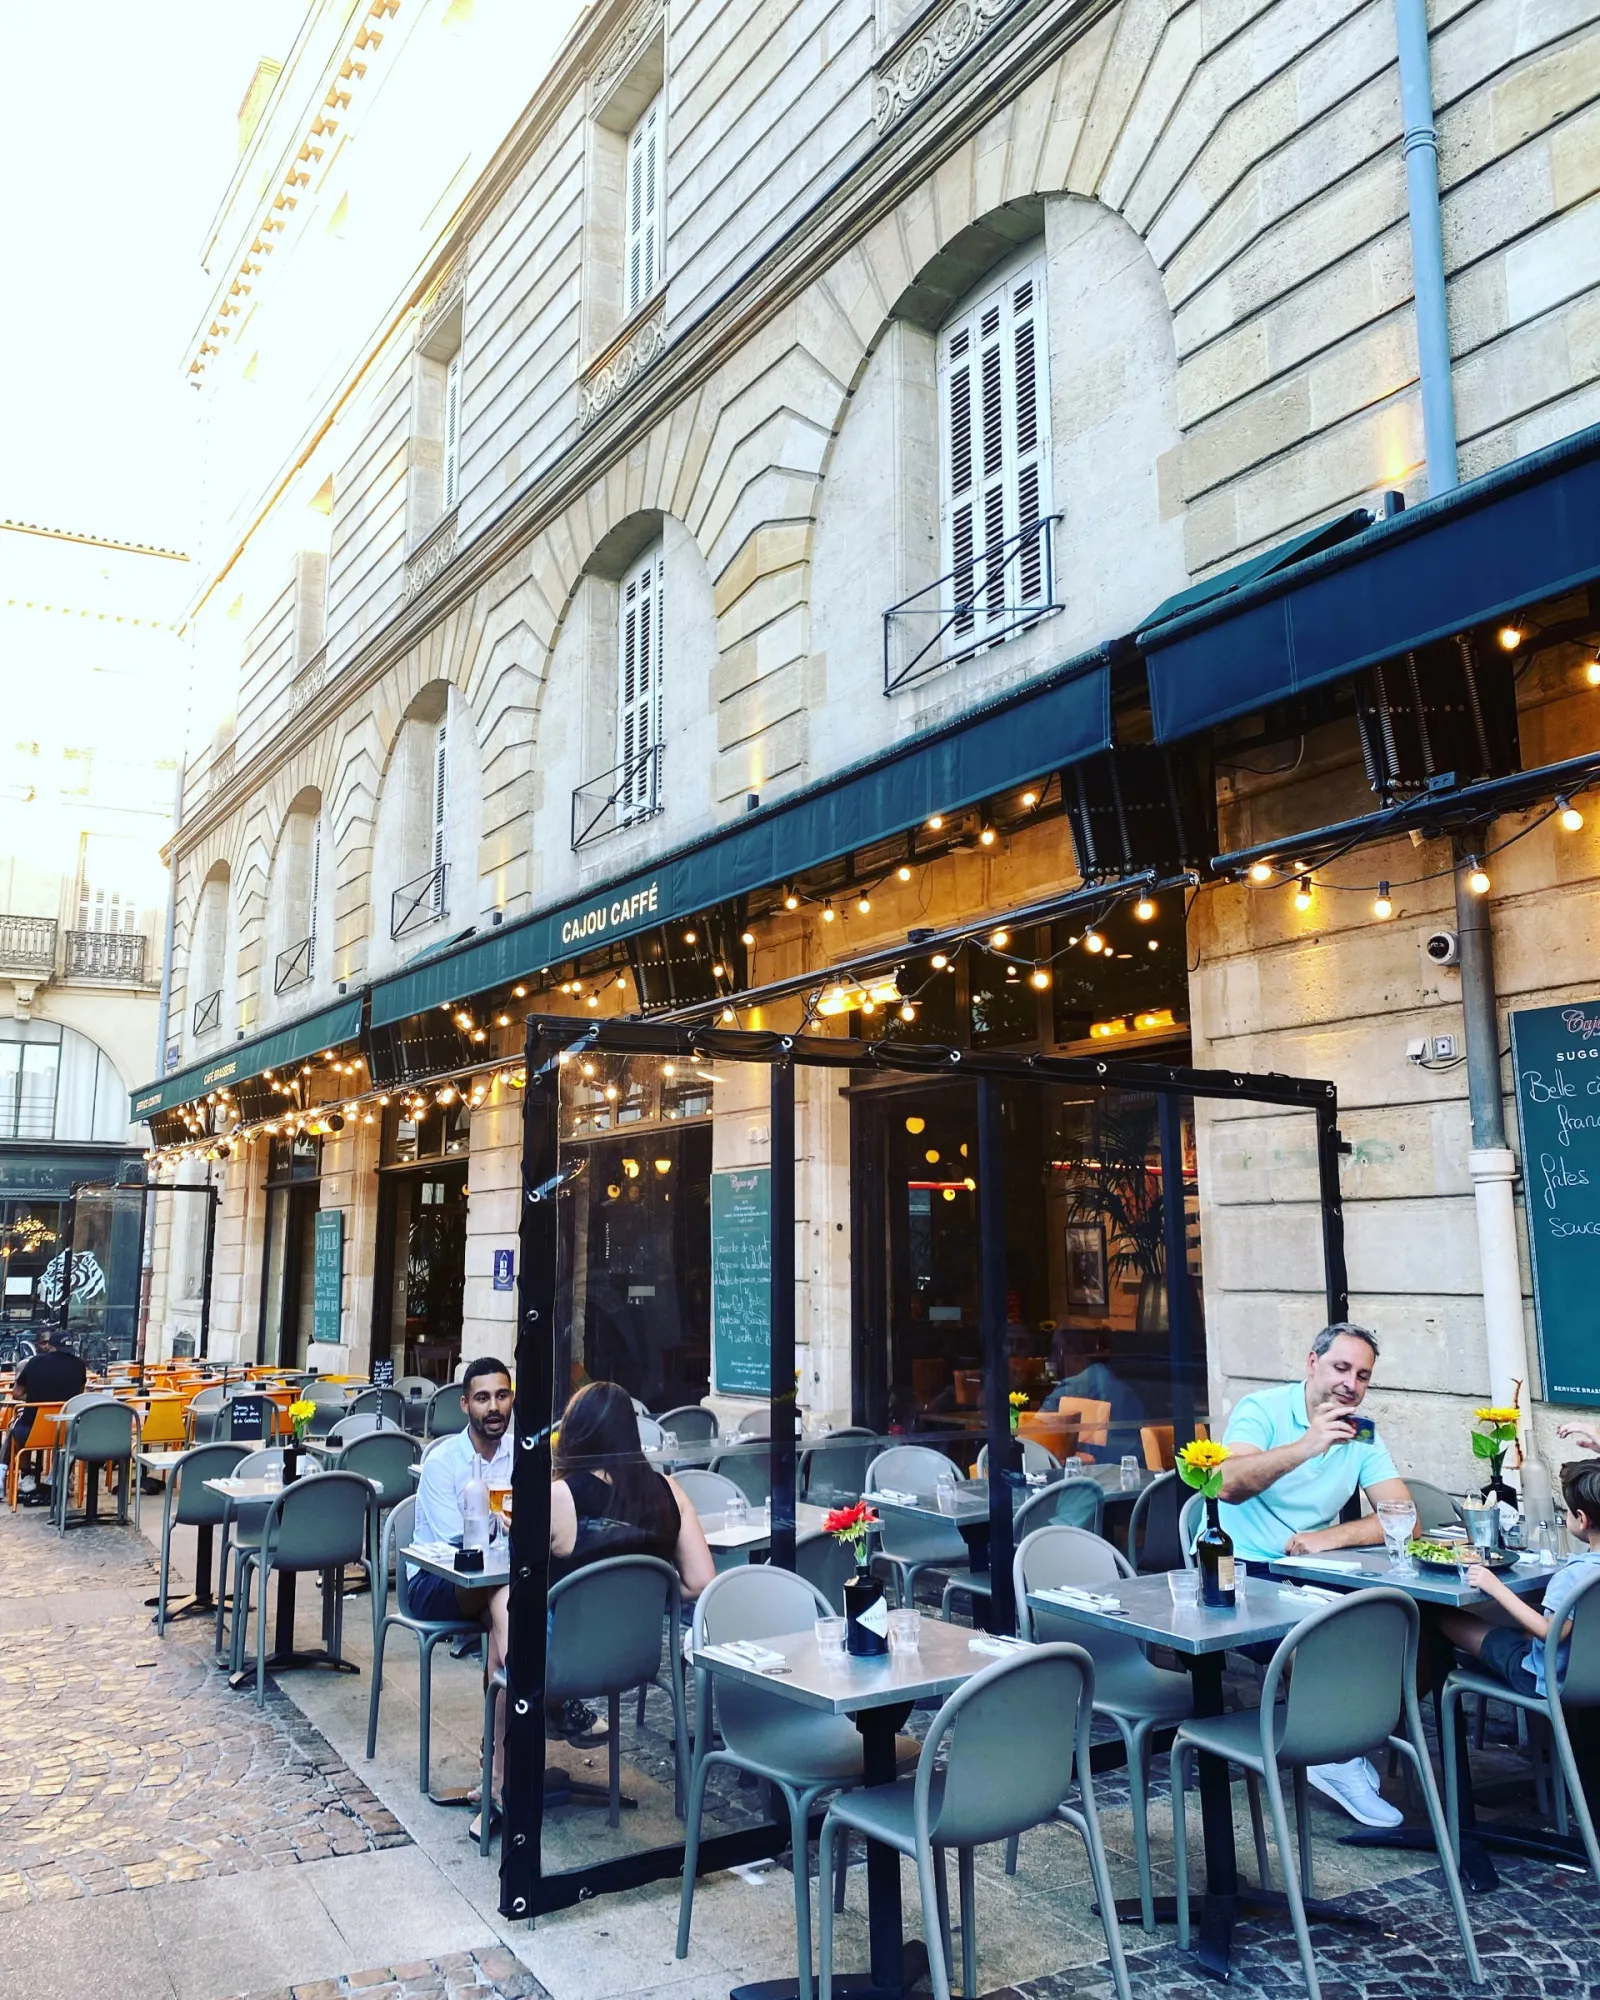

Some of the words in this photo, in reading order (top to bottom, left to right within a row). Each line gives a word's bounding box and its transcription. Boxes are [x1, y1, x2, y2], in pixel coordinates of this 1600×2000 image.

[562, 907, 607, 944] CAJOU
[610, 881, 658, 926] CAFFÉ
[1556, 1048, 1599, 1062] SUGG
[1522, 1068, 1577, 1103] Belle
